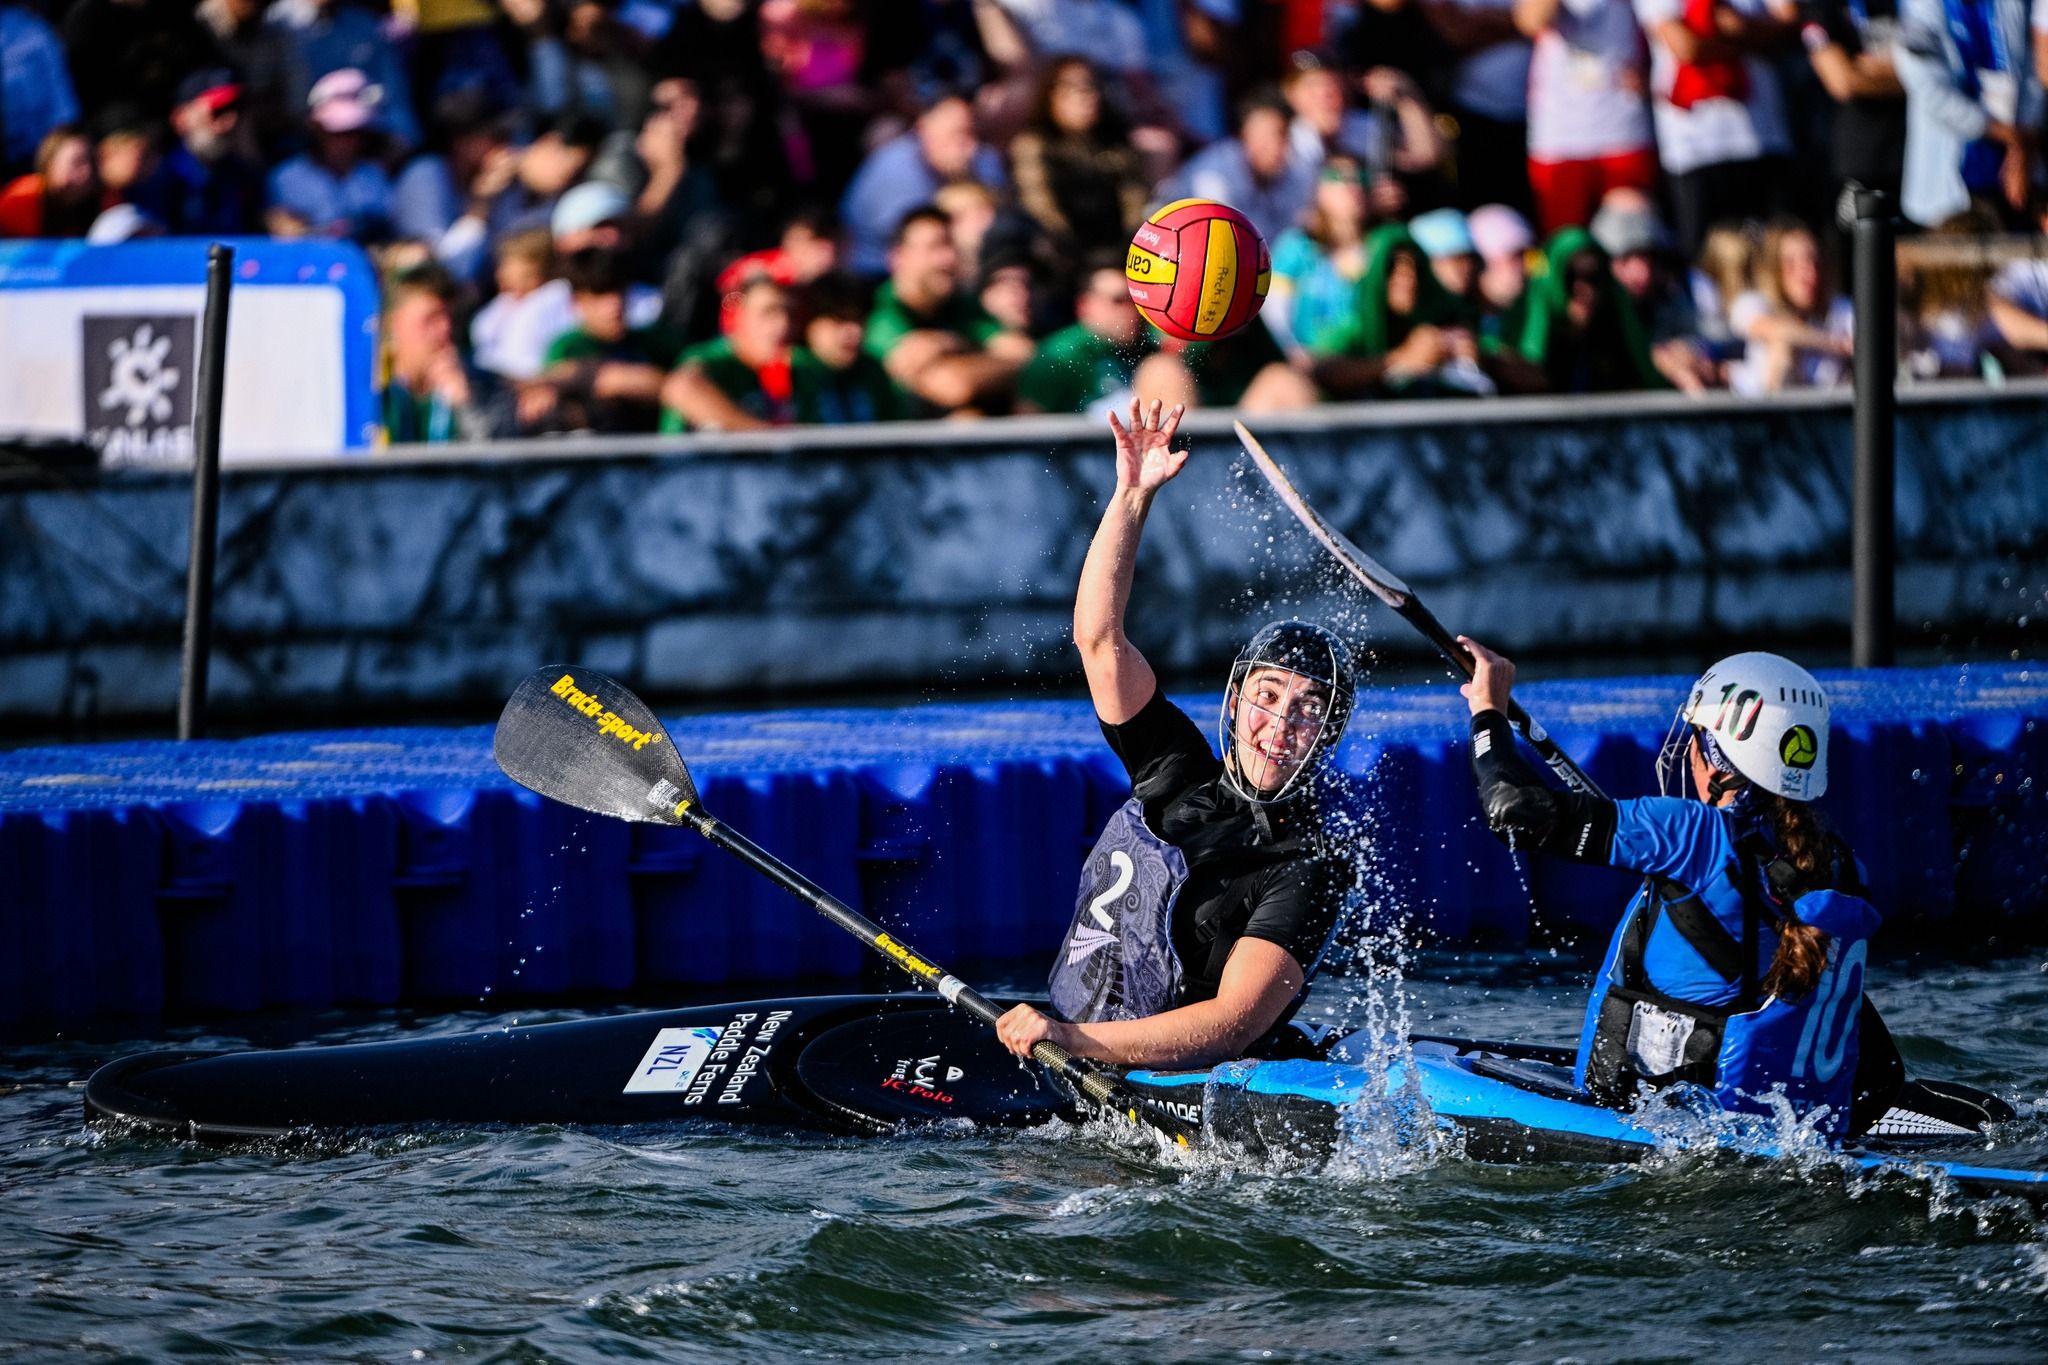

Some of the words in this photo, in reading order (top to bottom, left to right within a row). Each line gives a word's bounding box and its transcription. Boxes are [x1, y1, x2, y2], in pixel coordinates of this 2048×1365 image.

[1715, 682, 1763, 741] 10
[1089, 850, 1134, 932] 2
[755, 1010, 793, 1042] New
[1790, 937, 1868, 1083] 10
[646, 1045, 691, 1076] NZL
[710, 1013, 757, 1061] Paddle
[683, 1064, 727, 1105] Ferns
[717, 1044, 772, 1104] Zealand
